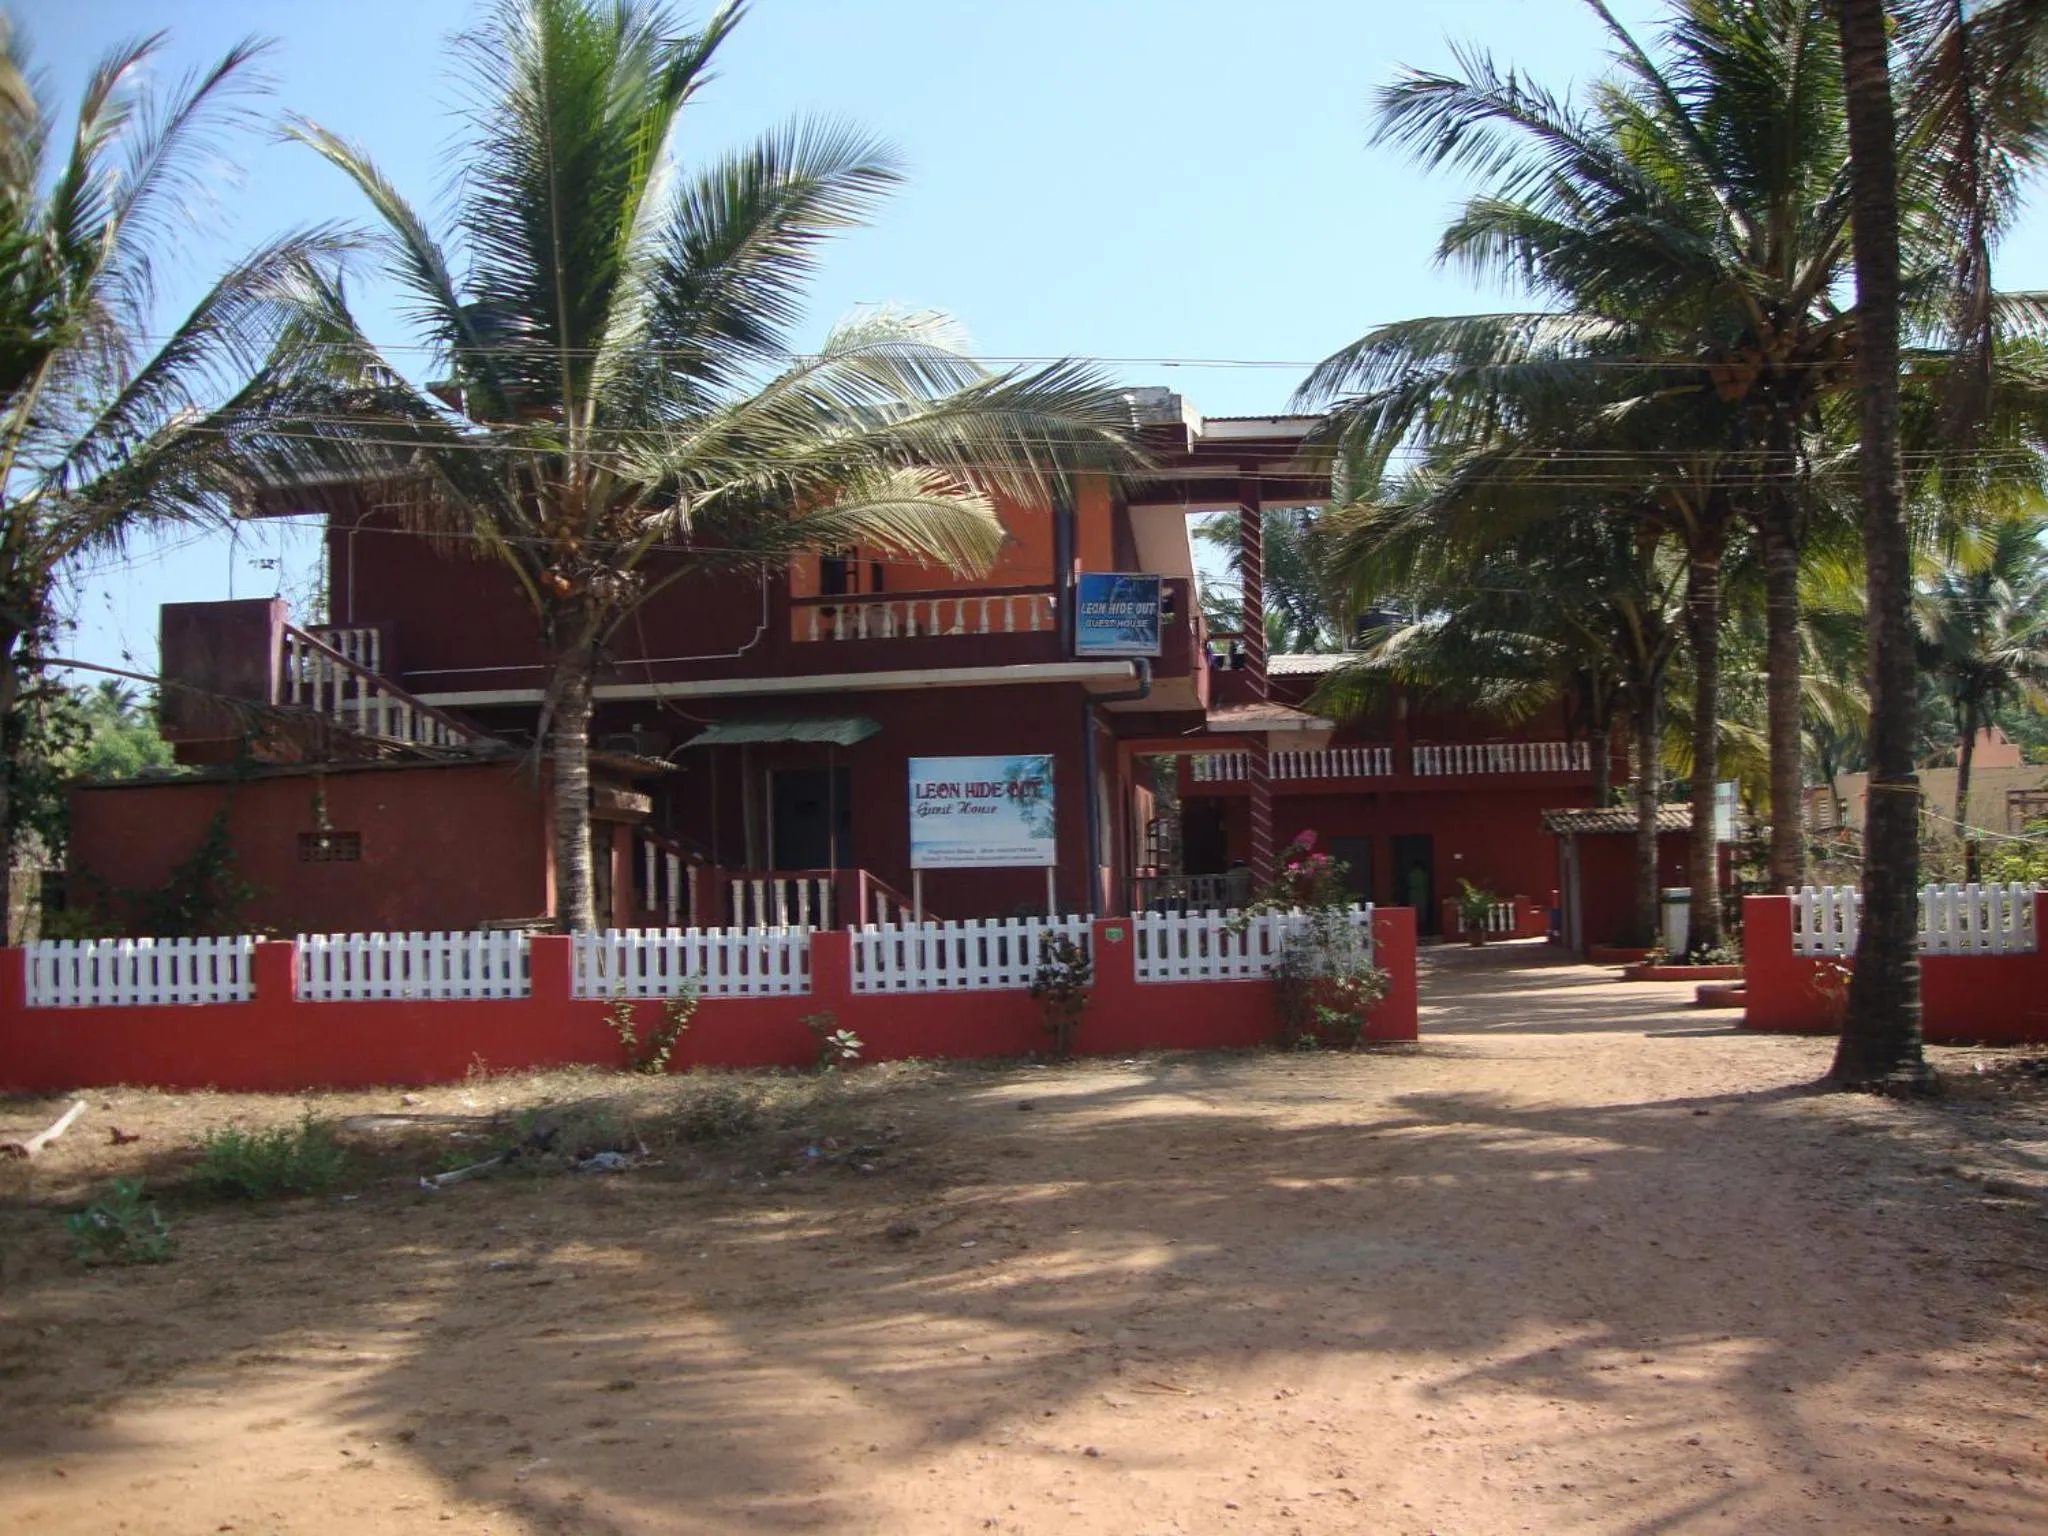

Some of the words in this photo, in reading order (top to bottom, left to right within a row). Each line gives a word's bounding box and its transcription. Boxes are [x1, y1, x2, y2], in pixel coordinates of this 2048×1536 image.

[1081, 602, 1107, 614] LEON
[1108, 602, 1134, 615] HIDE
[1134, 602, 1157, 615] OUT
[1087, 619, 1115, 628] GUEST
[1116, 619, 1149, 628] HOUSE
[915, 783, 960, 799] LEON
[965, 781, 1004, 798] HIDE
[1007, 779, 1043, 798] OUT
[917, 803, 951, 817] Guest
[957, 801, 998, 815] House
